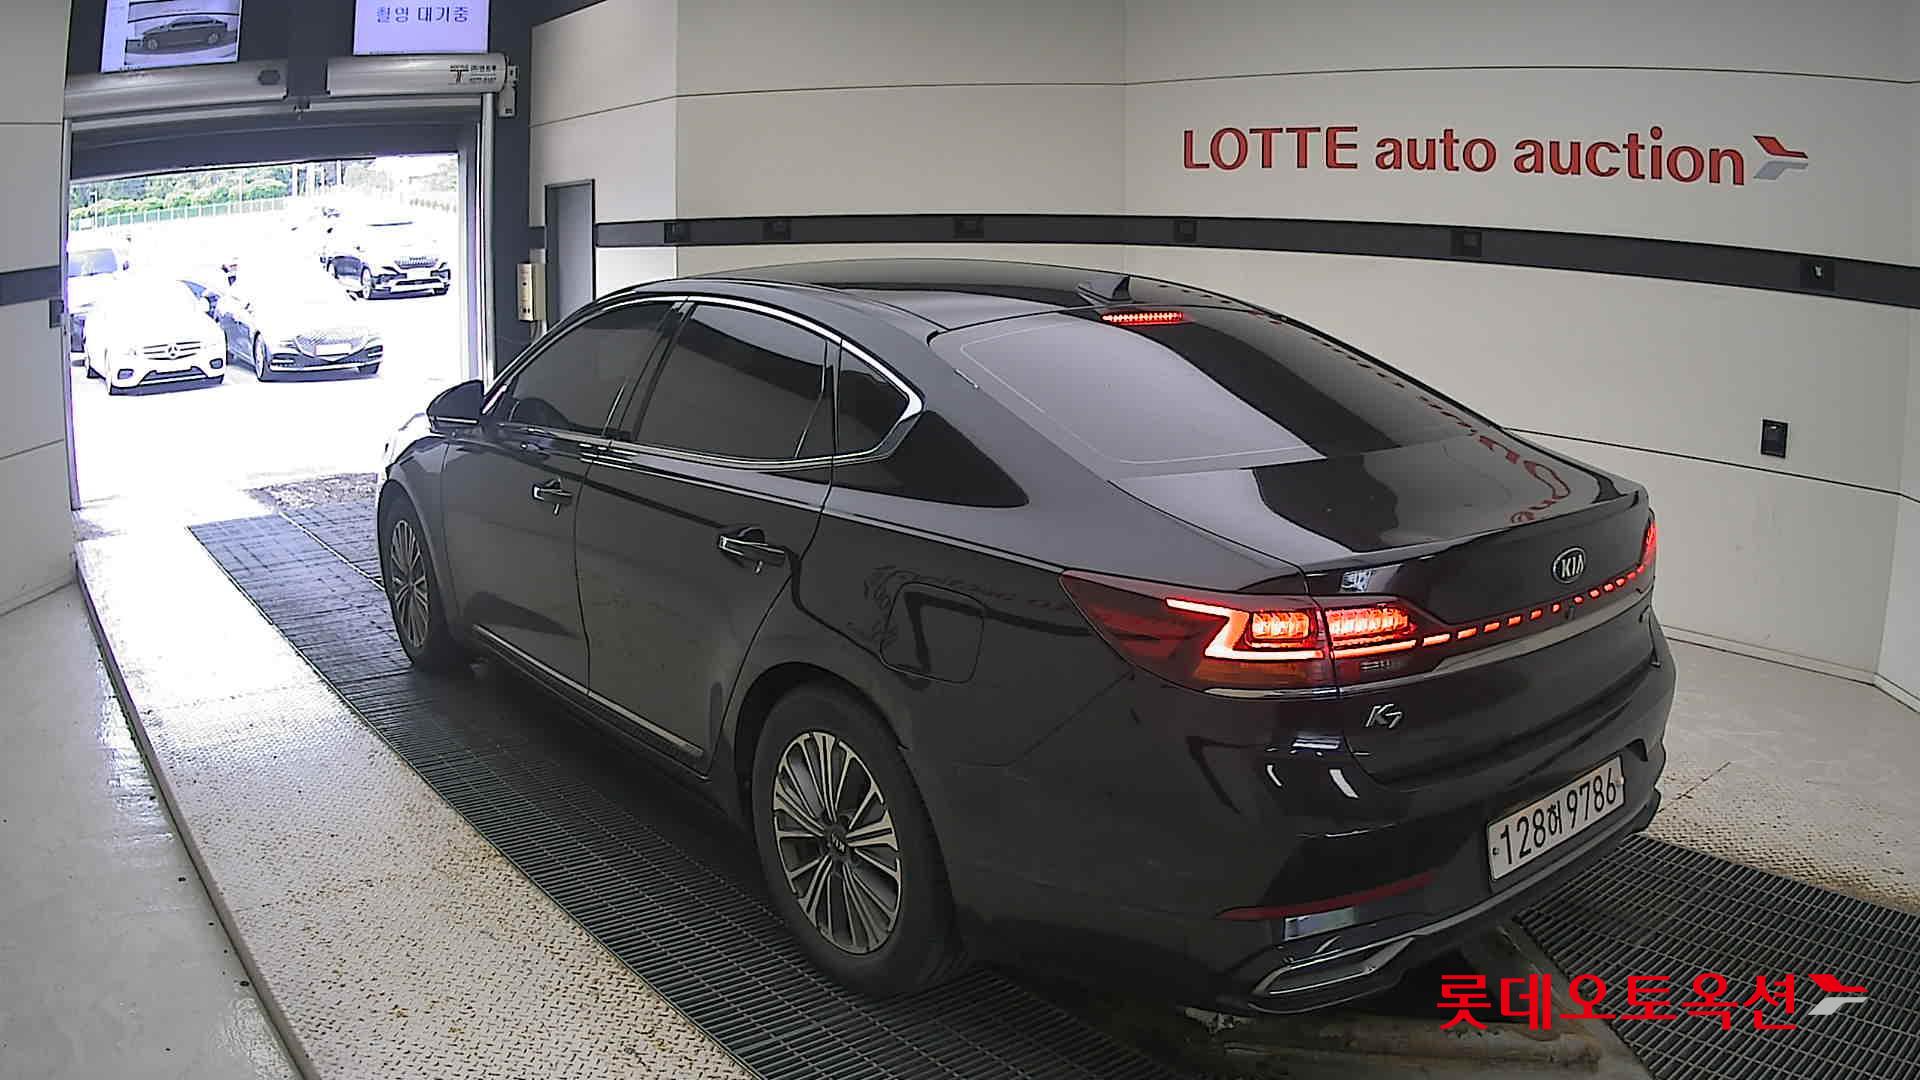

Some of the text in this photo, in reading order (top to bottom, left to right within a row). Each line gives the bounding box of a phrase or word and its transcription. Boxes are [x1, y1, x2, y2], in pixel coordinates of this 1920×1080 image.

[417, 7, 468, 23] 대기중
[1184, 126, 1744, 185] LOTTE auto auction
[1561, 554, 1584, 578] KIA
[1366, 703, 1402, 728] K7
